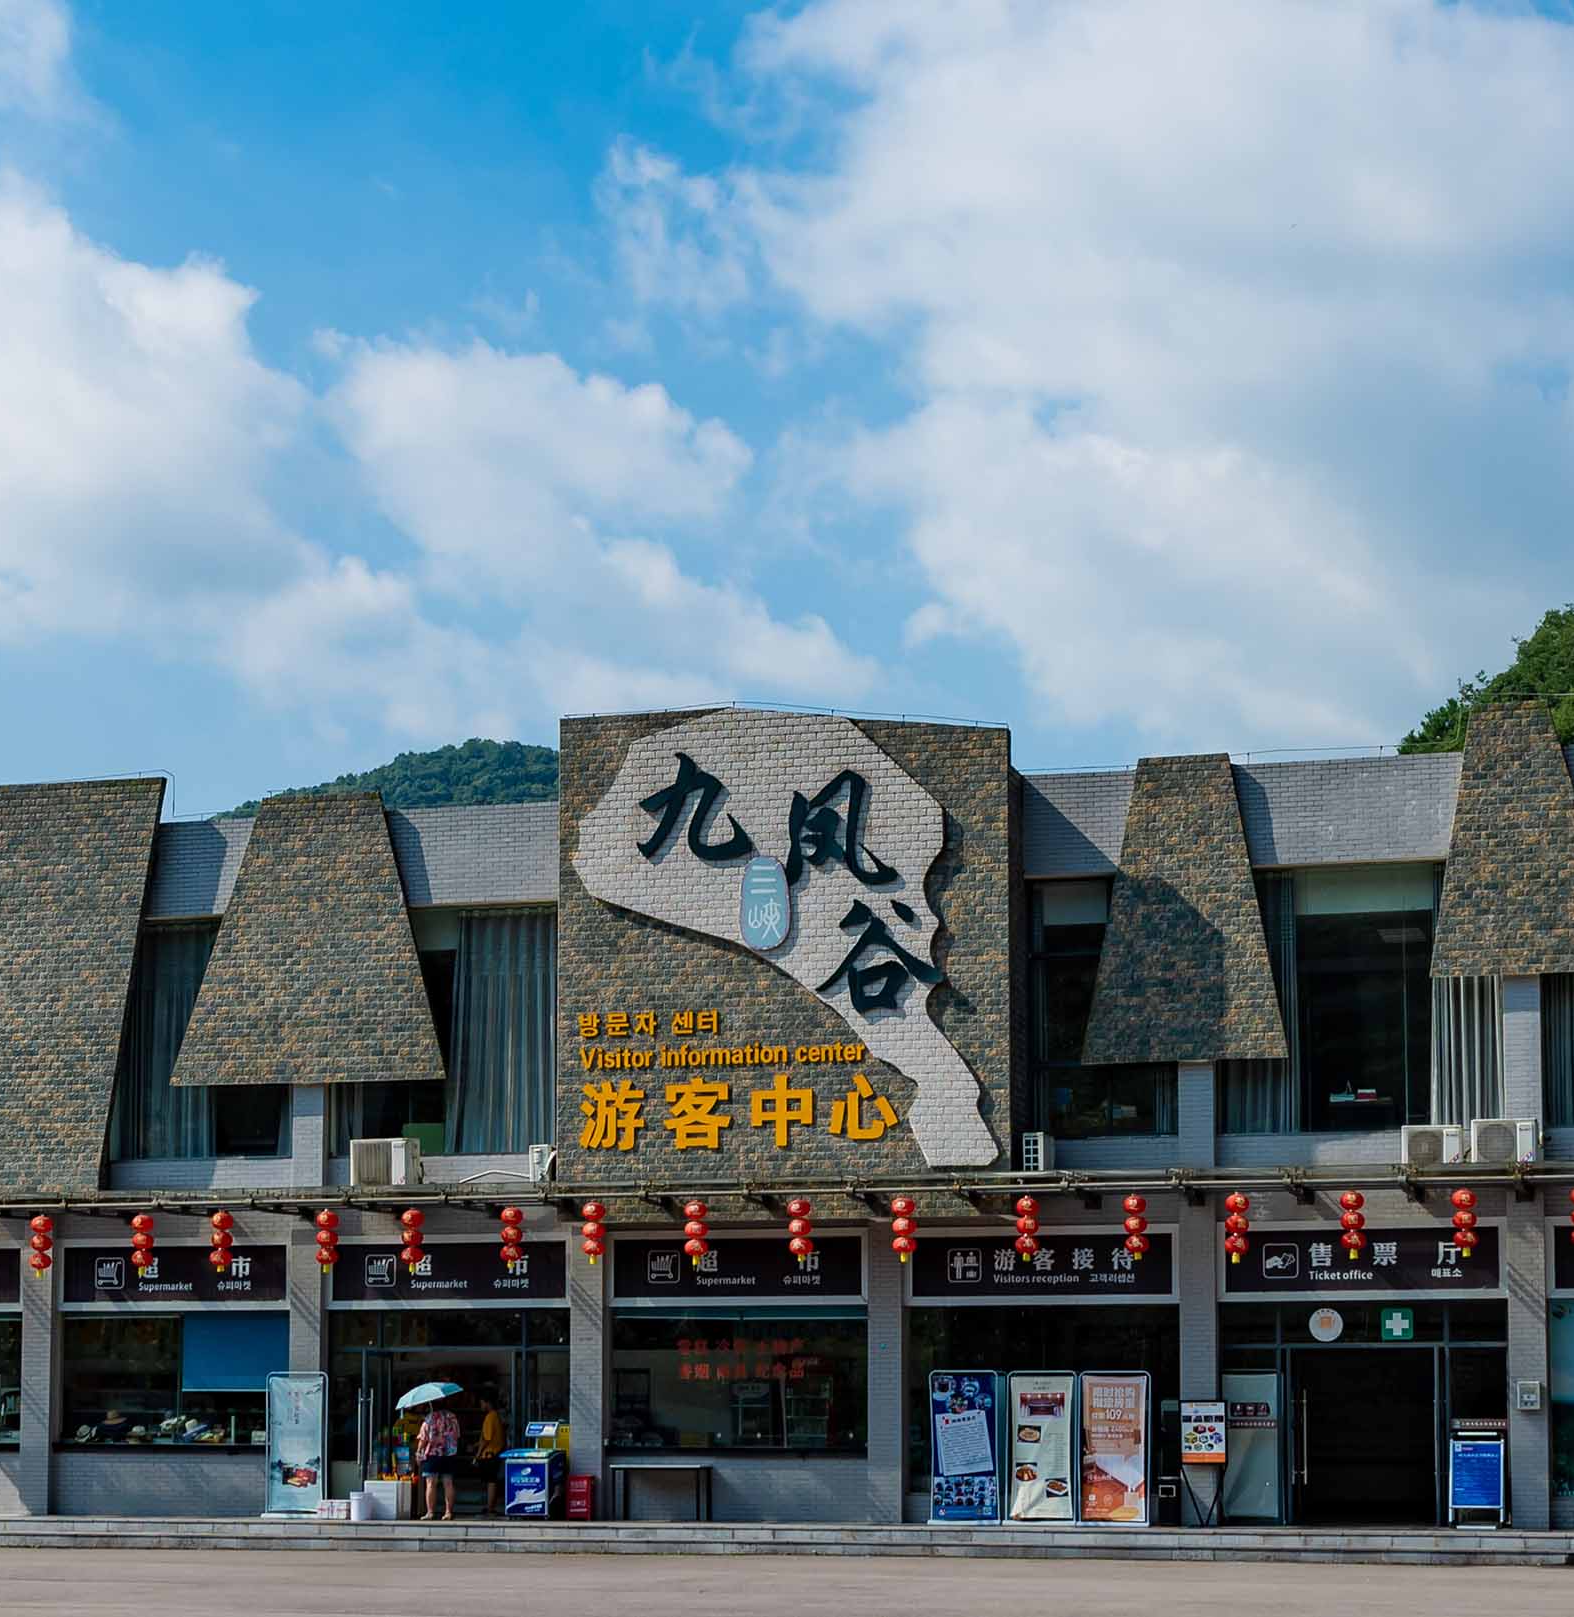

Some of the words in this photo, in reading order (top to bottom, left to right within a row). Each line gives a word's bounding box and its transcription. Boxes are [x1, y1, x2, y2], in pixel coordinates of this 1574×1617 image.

[578, 1010, 657, 1038] 방문자
[671, 1008, 719, 1035] 센터
[579, 1046, 653, 1070] Visitor
[660, 1043, 788, 1068] information
[795, 1040, 866, 1063] center
[579, 1073, 899, 1151] 游客中心
[993, 1247, 1134, 1271] 游客接待
[1308, 1240, 1462, 1267] 售票厅
[696, 1275, 757, 1287] Supermarket
[993, 1273, 1031, 1284] Visitors
[1032, 1273, 1080, 1285] reception
[1308, 1270, 1342, 1281] Ticket
[1342, 1270, 1374, 1281] office
[138, 1282, 194, 1293] Supermarket
[410, 1279, 468, 1291] Supermarket
